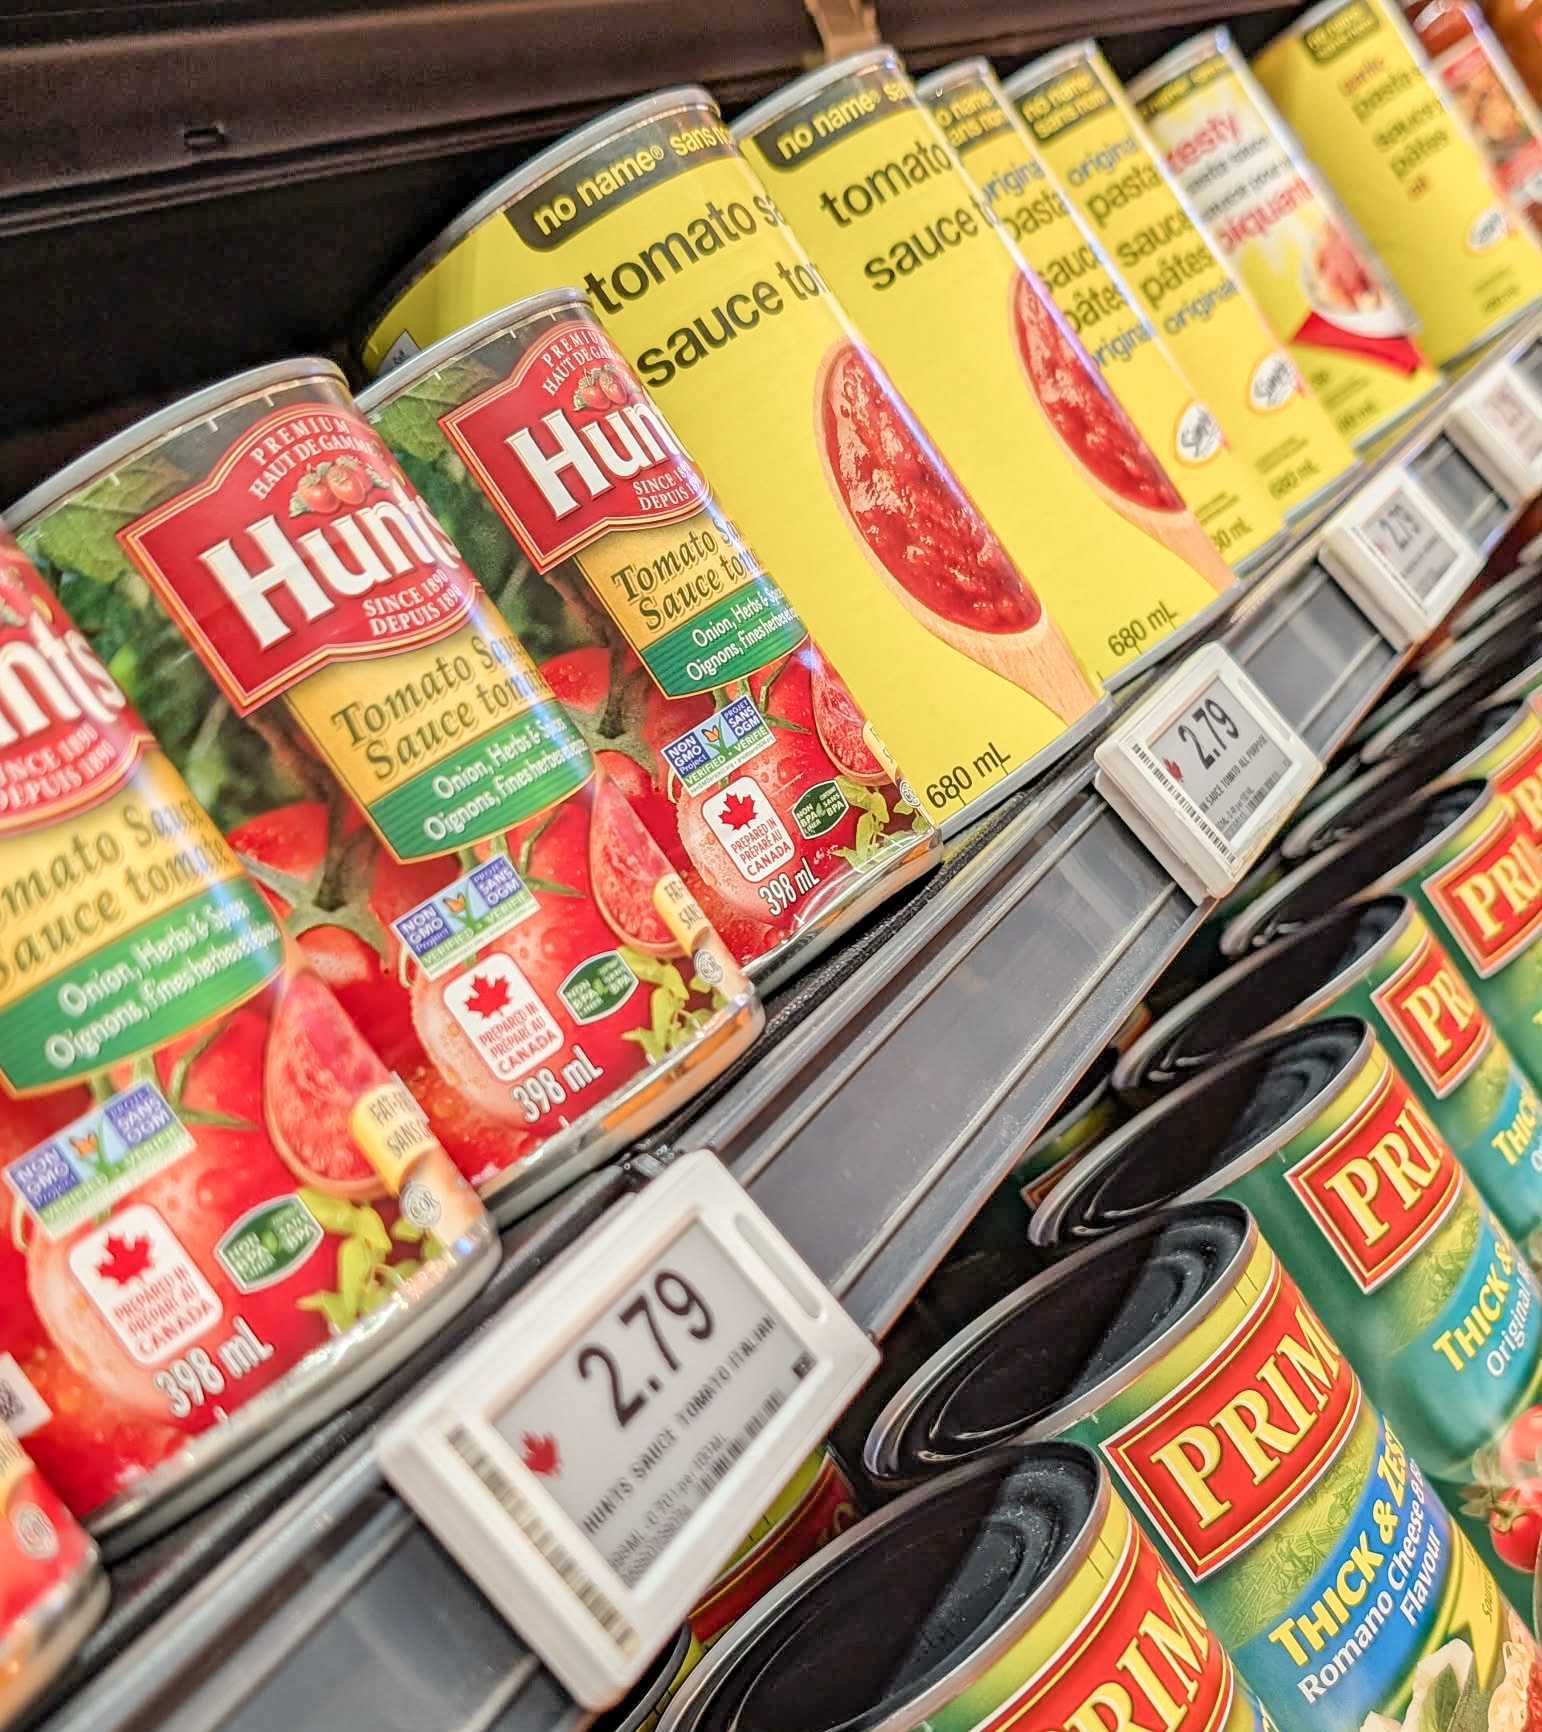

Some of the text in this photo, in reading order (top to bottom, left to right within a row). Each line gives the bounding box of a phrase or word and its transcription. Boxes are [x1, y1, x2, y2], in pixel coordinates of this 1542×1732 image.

[776, 126, 815, 161] no
[532, 194, 578, 236] no
[667, 124, 713, 158] sans
[818, 138, 954, 229] tomato
[582, 198, 758, 315] tomato
[863, 207, 980, 291] sauce
[636, 278, 787, 388] sauce
[542, 357, 577, 396] HAUT
[248, 415, 352, 467] PREMIUM
[247, 438, 322, 501] HAUT DE
[632, 472, 677, 496] SINCE
[637, 485, 690, 511] DEPUIS
[610, 529, 716, 603] Tomato
[362, 587, 422, 619] SINCE
[368, 604, 441, 637] DEPUIS
[638, 570, 722, 630] Sauce
[692, 613, 738, 648] Onion,
[730, 596, 764, 623] Herbs
[1107, 599, 1180, 658] 680 mL
[686, 643, 744, 681] Oignons,
[330, 654, 474, 749] Tomato
[723, 699, 749, 720] PROJET
[728, 706, 755, 728] SANS
[734, 715, 760, 737] OGM
[365, 701, 478, 782] Sauce
[667, 735, 697, 759] NON
[674, 745, 702, 767] GMO
[1178, 697, 1240, 770] 2.79
[432, 763, 495, 800] Onion,
[679, 755, 708, 775] Project
[685, 754, 726, 786] VERIFIED
[926, 765, 973, 808] 680
[973, 741, 1012, 778] mL
[422, 790, 502, 842] Oignons,
[730, 816, 778, 854] PREPARED IN
[771, 829, 784, 842] AU
[796, 803, 815, 819] NON
[800, 811, 819, 828] BPA
[826, 801, 845, 818] BPA
[0, 830, 122, 930] mato
[746, 841, 792, 877] CANADA
[487, 879, 521, 904] OGM
[758, 857, 822, 917] 398 mL
[401, 905, 437, 932] NON
[410, 916, 444, 945] GMO
[58, 961, 144, 1017] Onion,
[45, 998, 152, 1070] Oignons,
[478, 1007, 528, 1046] PREPARED
[496, 1031, 558, 1076] CANADA
[510, 1044, 605, 1124] 398 mL
[16, 1146, 61, 1184] NON
[26, 1162, 70, 1196] GMO
[137, 1298, 216, 1356] CANADA
[1432, 1264, 1512, 1373] THICK
[1486, 1285, 1532, 1377] Original
[154, 1314, 276, 1418] 398 mL
[576, 1270, 715, 1428] 2.79
[1150, 1305, 1342, 1530] PRIM
[580, 1476, 635, 1536] HUNTS
[632, 1427, 678, 1481] SAUCE
[675, 1364, 731, 1426] TOMATO
[1268, 1531, 1386, 1668] THICK
[1372, 1498, 1399, 1545] &
[1295, 1590, 1394, 1705] Romano
[1387, 1499, 1427, 1592] Cheese
[1398, 1523, 1442, 1629] Flavour
